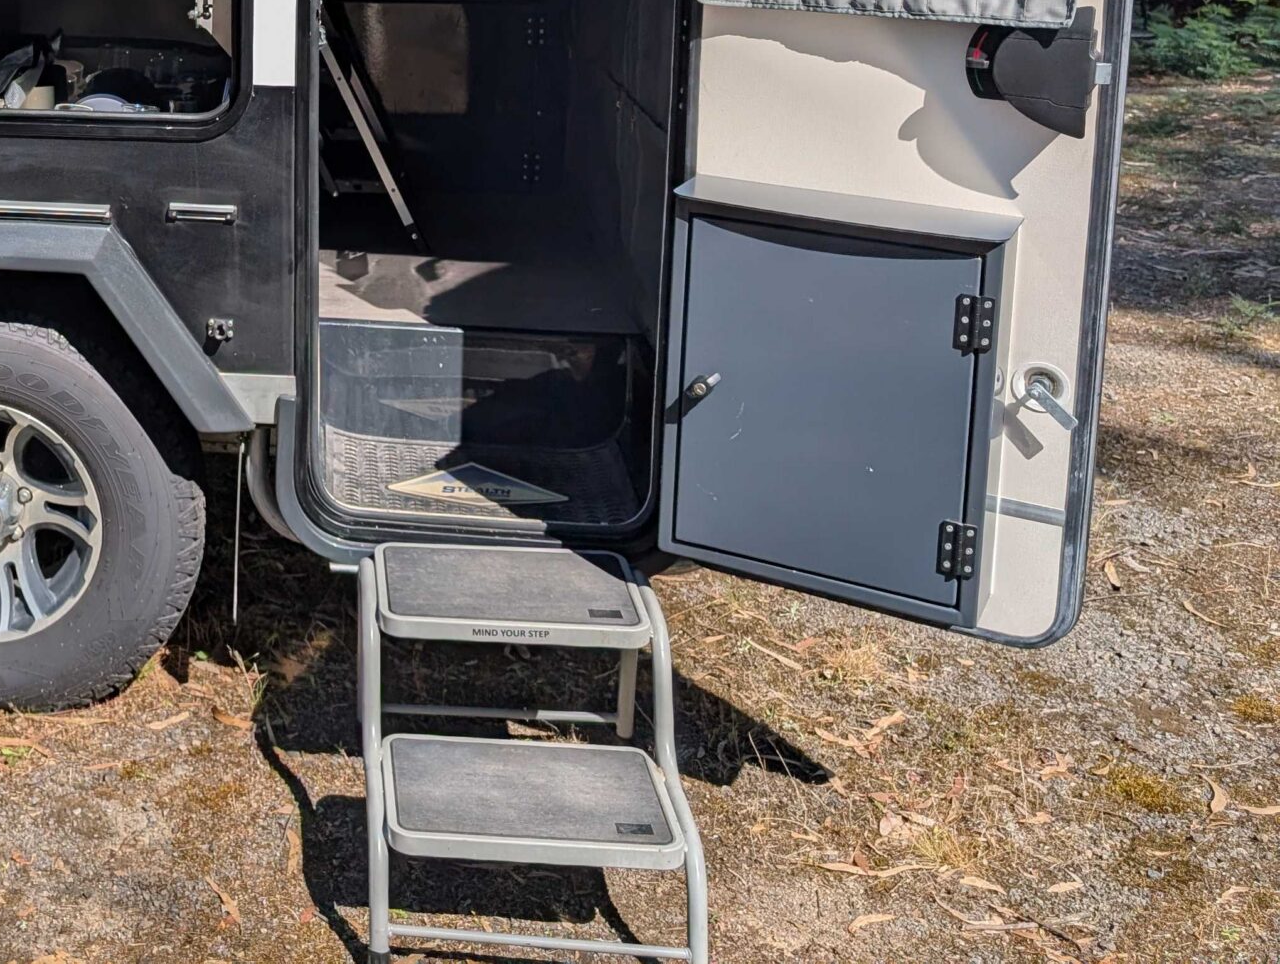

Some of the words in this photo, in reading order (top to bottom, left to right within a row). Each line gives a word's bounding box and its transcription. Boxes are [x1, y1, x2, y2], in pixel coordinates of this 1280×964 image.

[442, 484, 512, 498] STEALTH
[472, 628, 499, 637] MIND
[500, 629, 526, 638] YOUR
[528, 630, 550, 638] STEP
